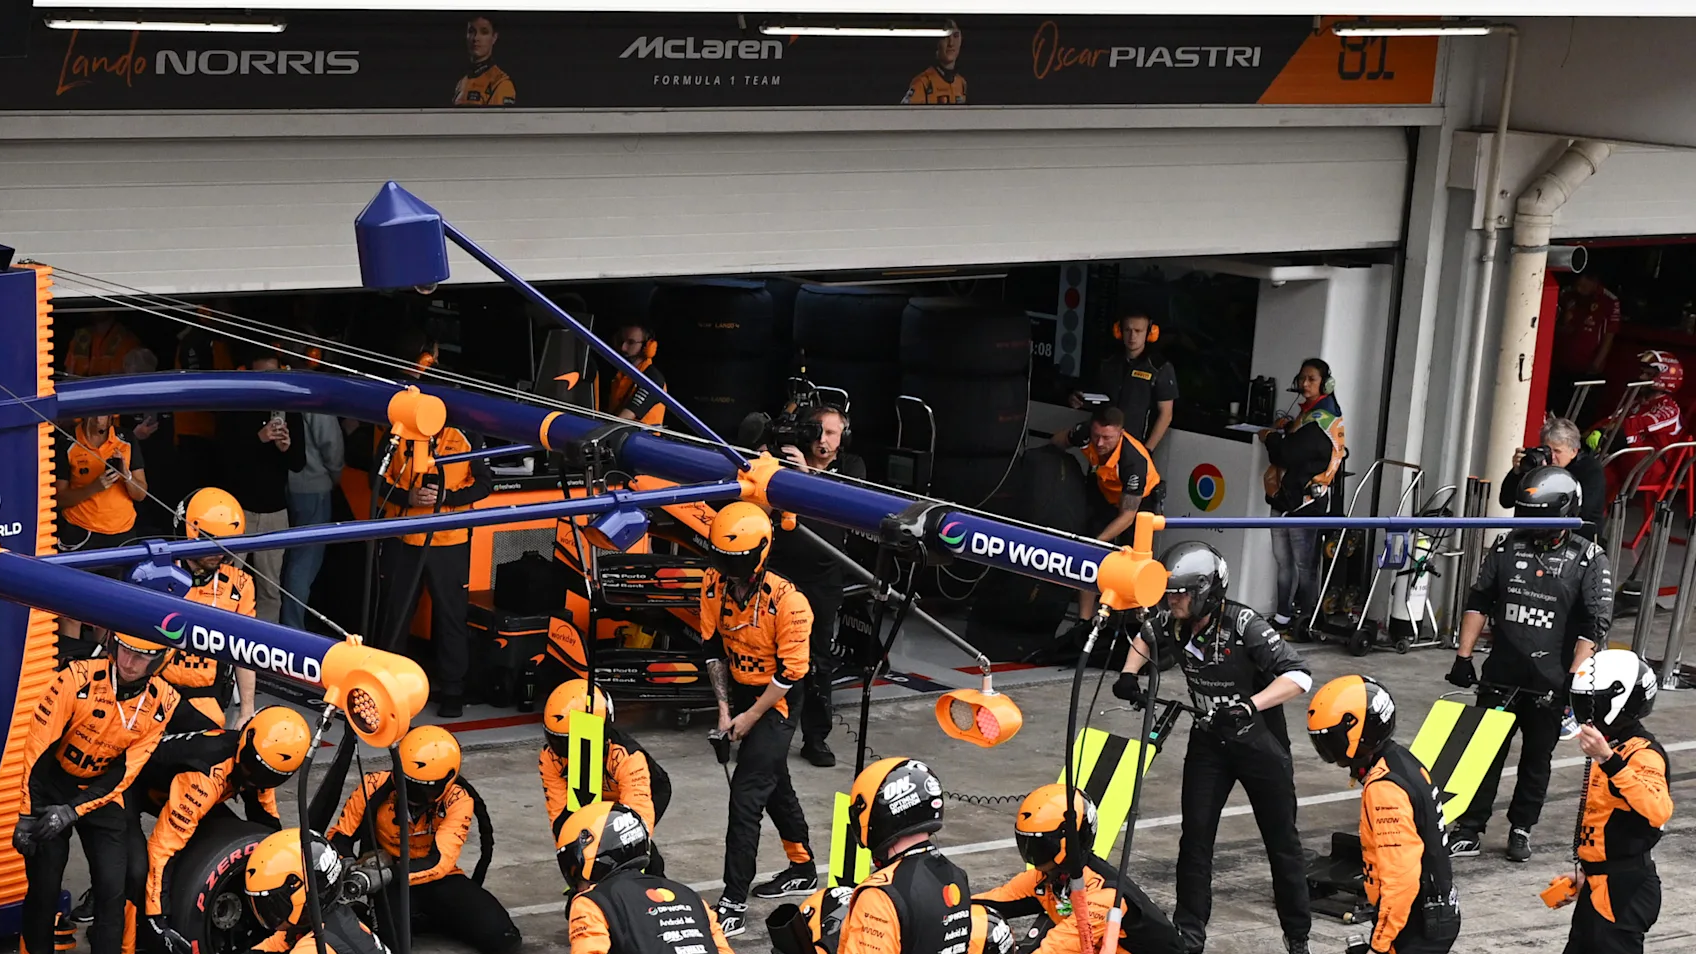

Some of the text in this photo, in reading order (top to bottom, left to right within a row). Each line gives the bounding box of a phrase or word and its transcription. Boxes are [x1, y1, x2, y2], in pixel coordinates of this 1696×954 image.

[619, 36, 783, 59] McLaren
[1032, 20, 1262, 80] Oscar PIASTRI
[56, 29, 360, 96] Lando NORRIS
[1337, 36, 1396, 80] 81
[654, 75, 781, 85] FORMULA 1 TEAM
[971, 531, 1098, 583] DP WORLD
[1523, 589, 1557, 602] Technologies
[1505, 603, 1555, 629] OKX
[551, 632, 576, 646] workday
[192, 625, 321, 683] DP WORLD
[191, 783, 209, 798] allwyn
[884, 775, 910, 800] ON
[179, 803, 193, 816] okta
[889, 792, 919, 810] OPTIMUM
[891, 798, 922, 815] NUTRITION
[196, 842, 259, 913] P ZERO
[660, 918, 684, 927] Android
[944, 930, 962, 941] Android
